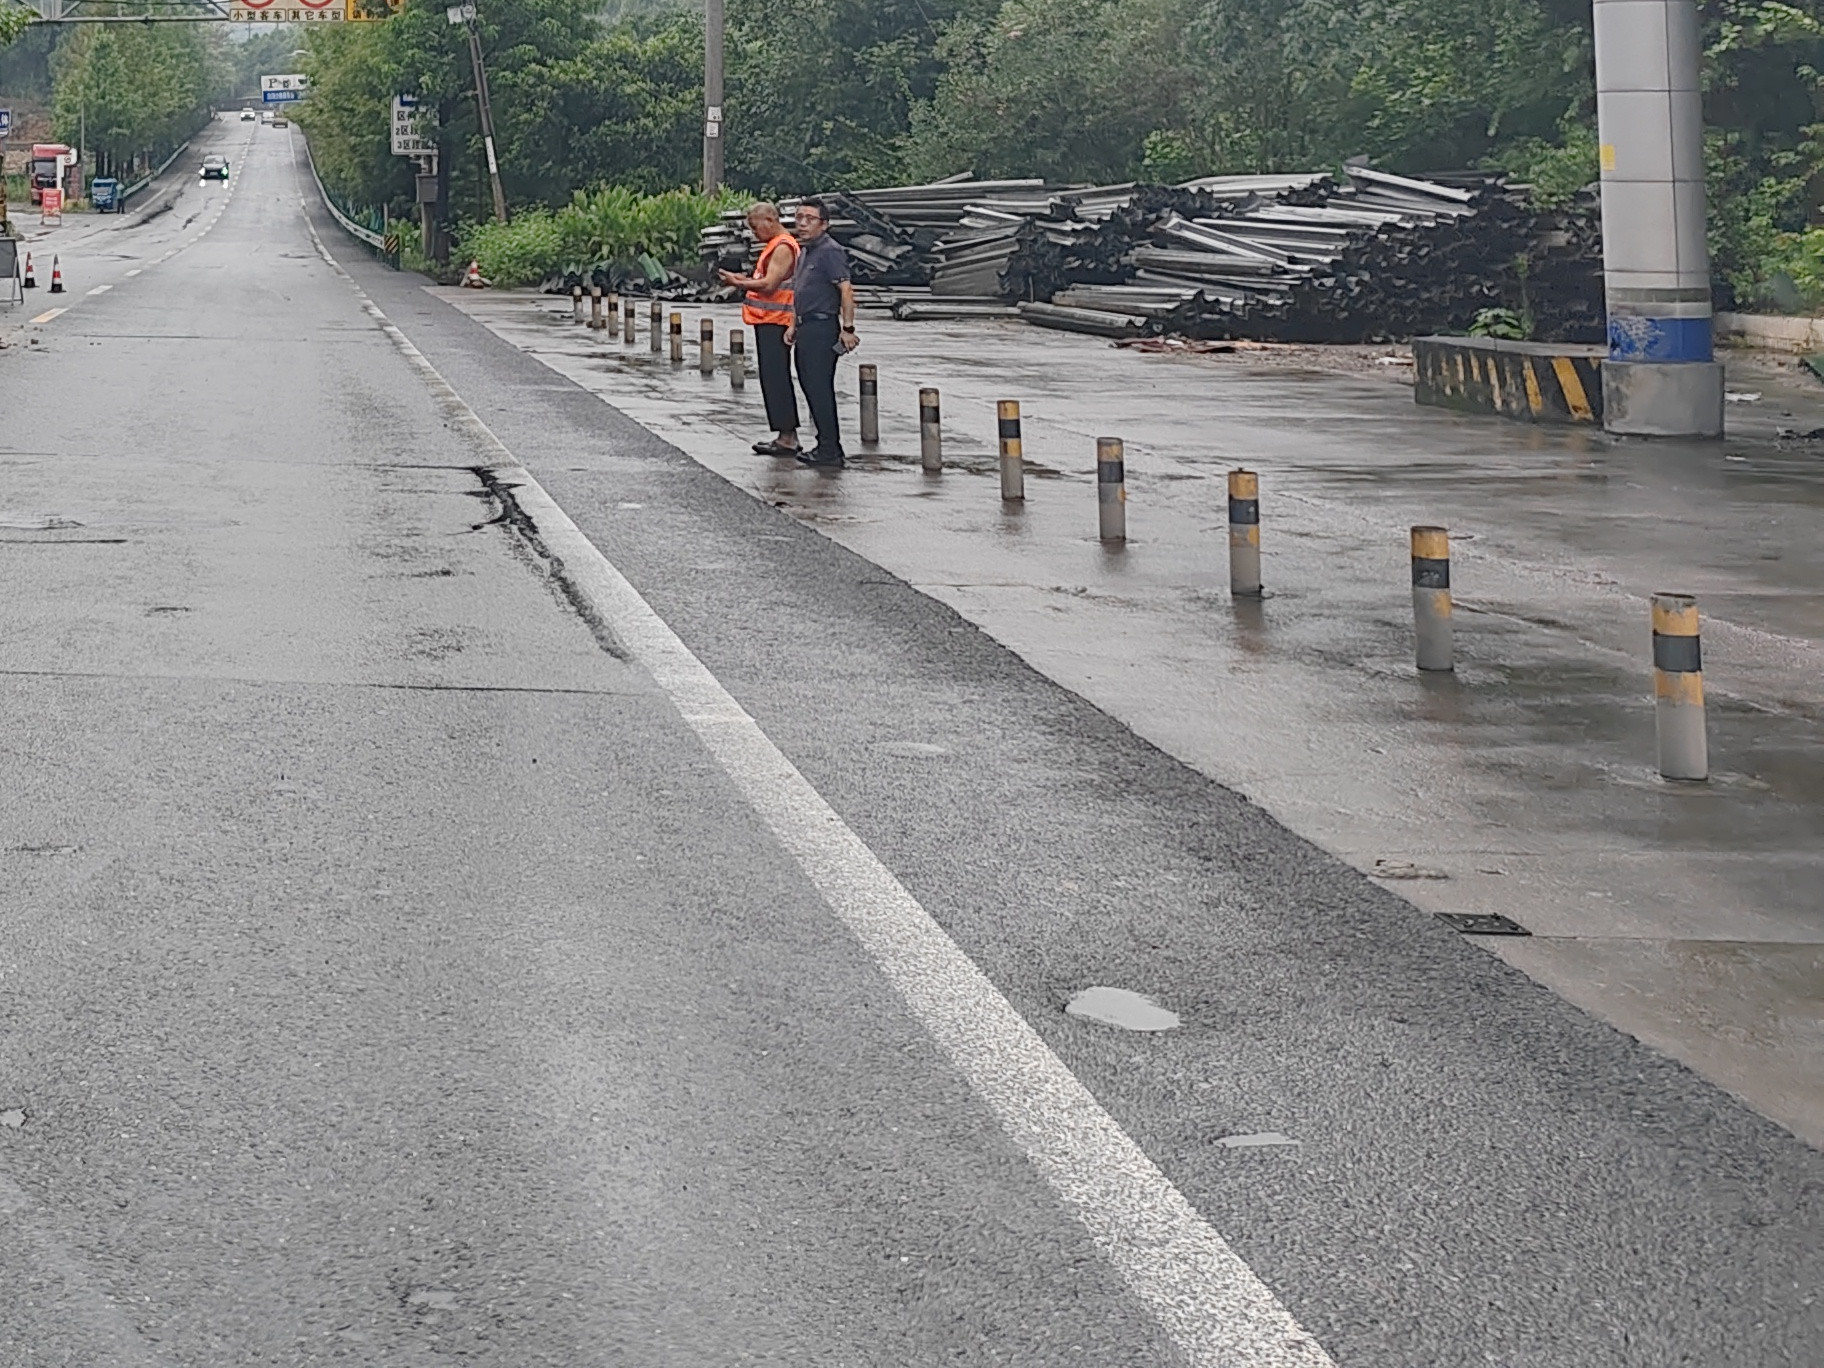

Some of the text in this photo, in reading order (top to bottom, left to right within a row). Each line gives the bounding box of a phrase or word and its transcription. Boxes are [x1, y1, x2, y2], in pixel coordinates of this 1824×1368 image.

[233, 10, 284, 20] 小型客车
[291, 10, 341, 20] 其它车型
